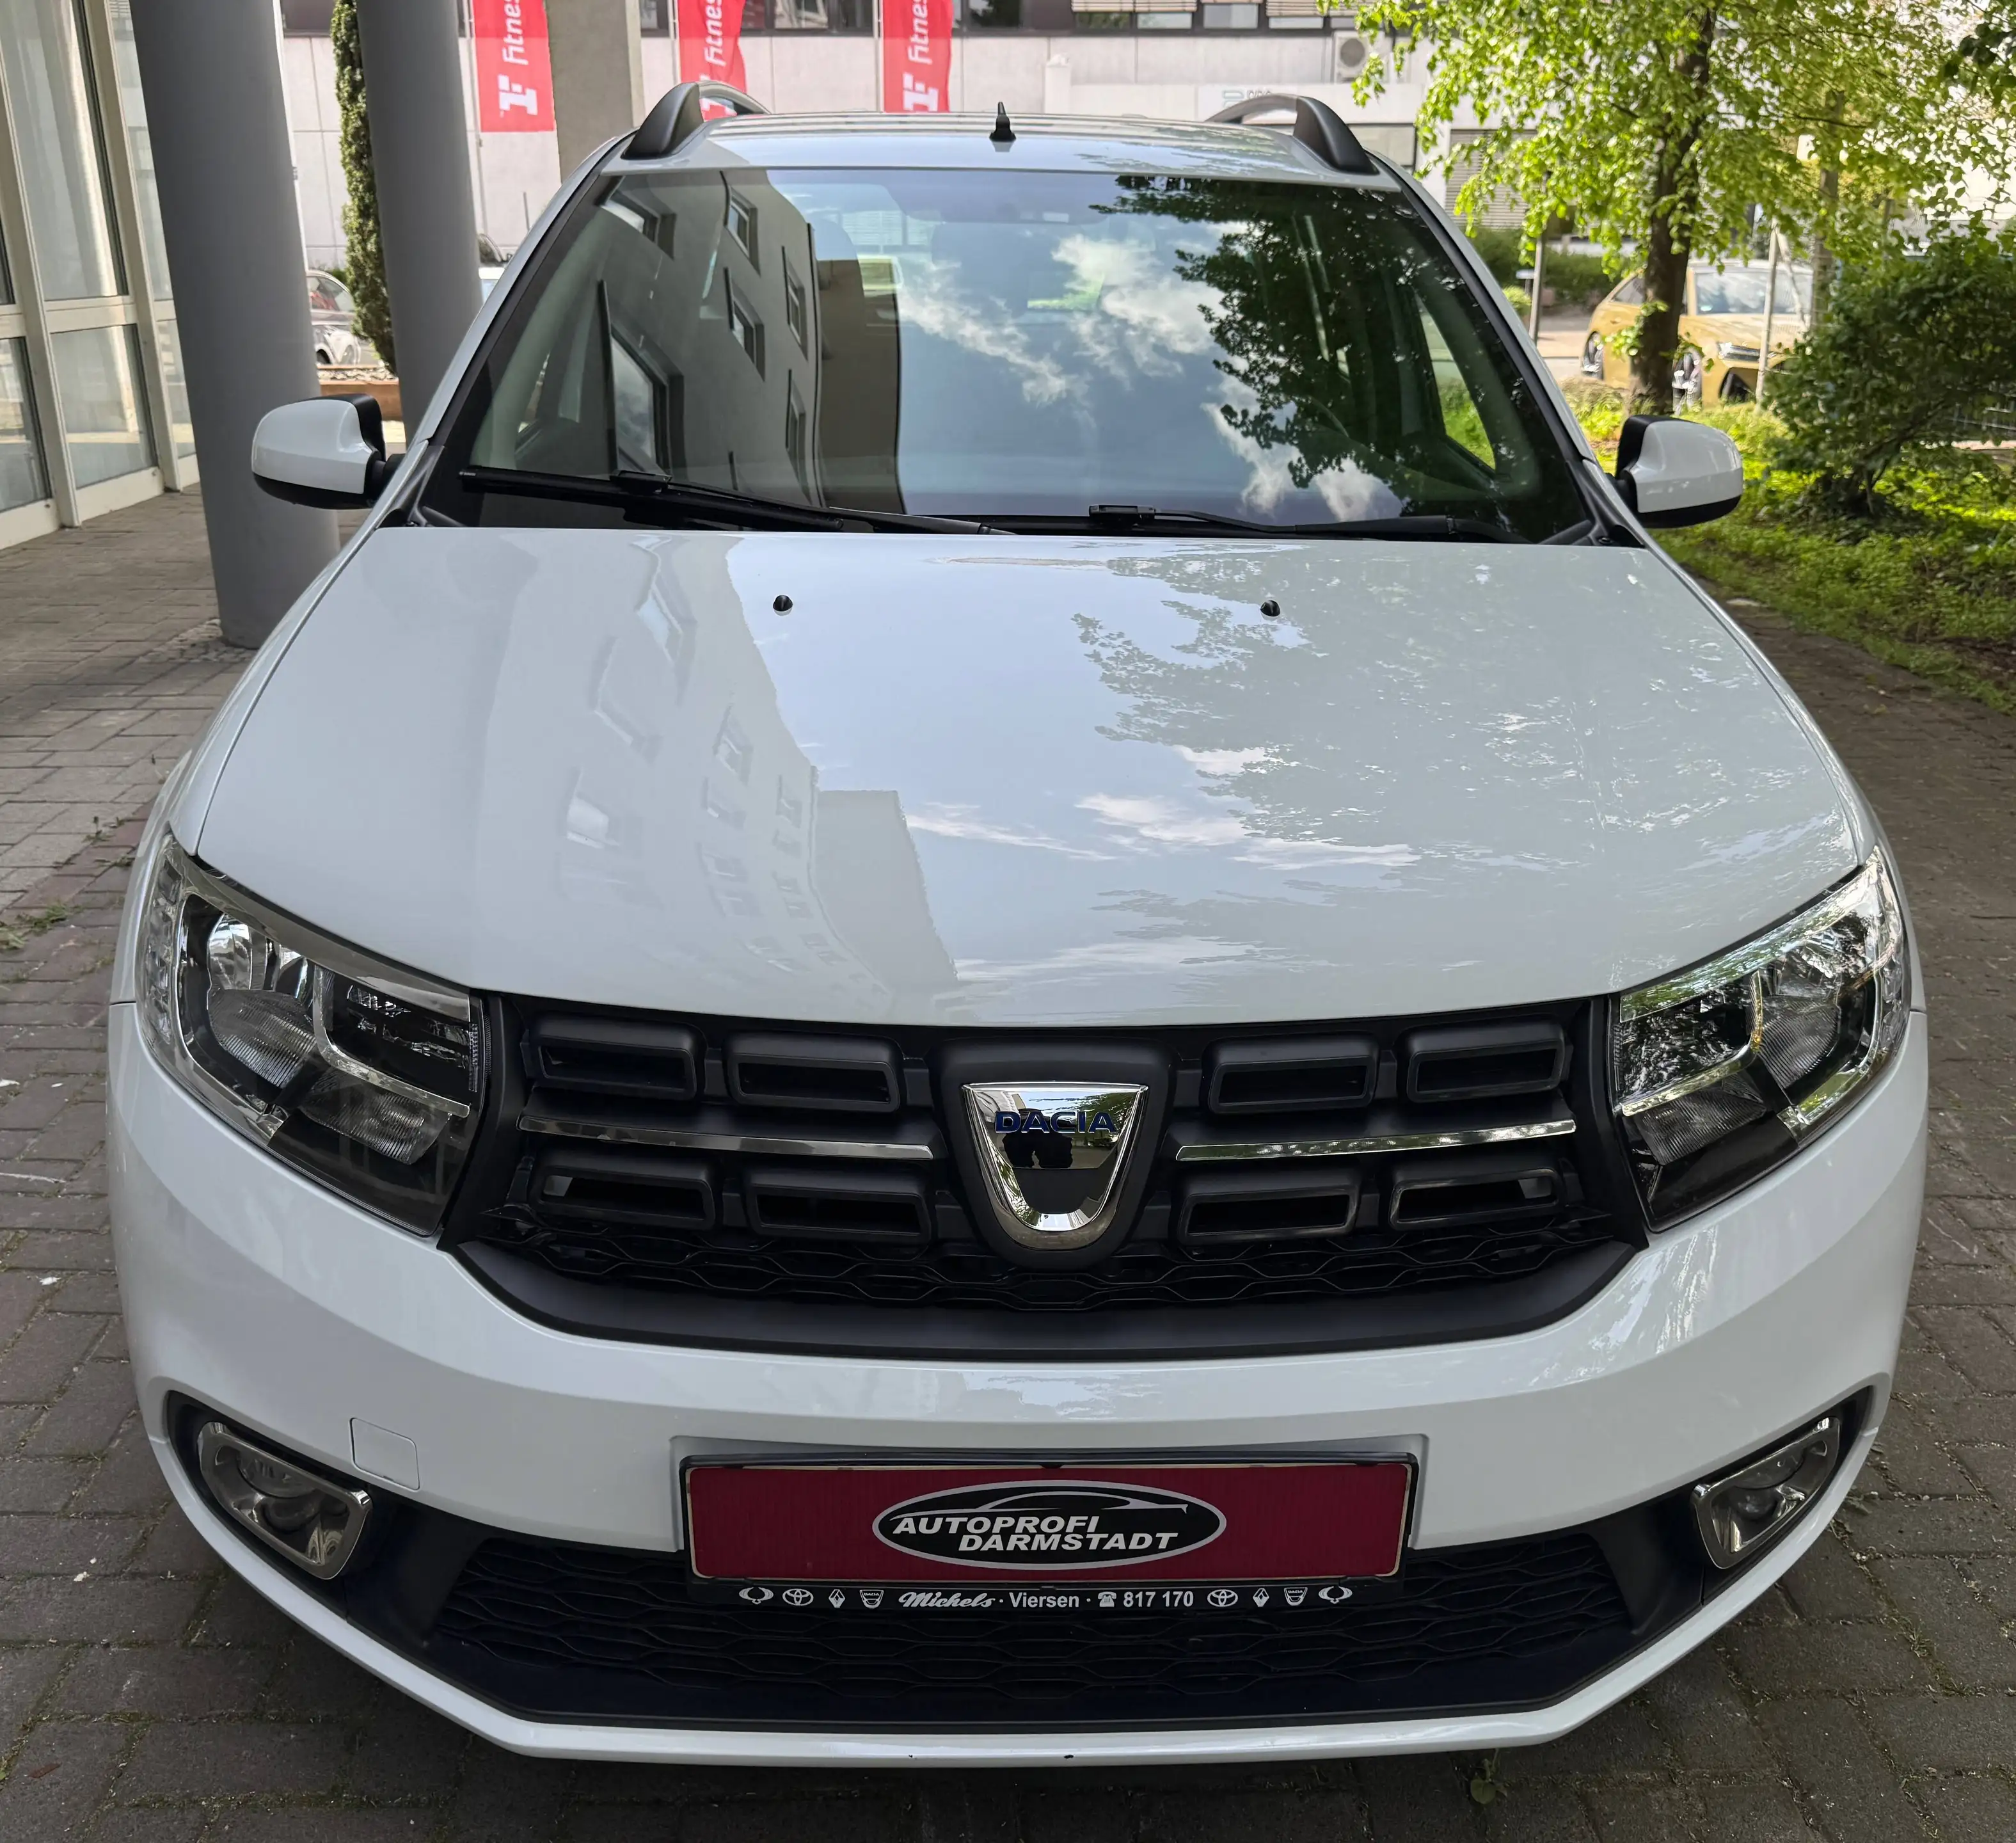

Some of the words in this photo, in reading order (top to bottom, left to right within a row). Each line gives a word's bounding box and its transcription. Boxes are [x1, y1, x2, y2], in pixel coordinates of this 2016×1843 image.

[995, 1111, 1117, 1134] DACIA
[893, 1515, 1100, 1535] AUTOPROFI
[958, 1532, 1179, 1551] DARMSTADT
[898, 1592, 996, 1608] Michels
[1009, 1592, 1079, 1608] Viersen
[1123, 1591, 1154, 1608] 817
[1162, 1590, 1194, 1608] 170
